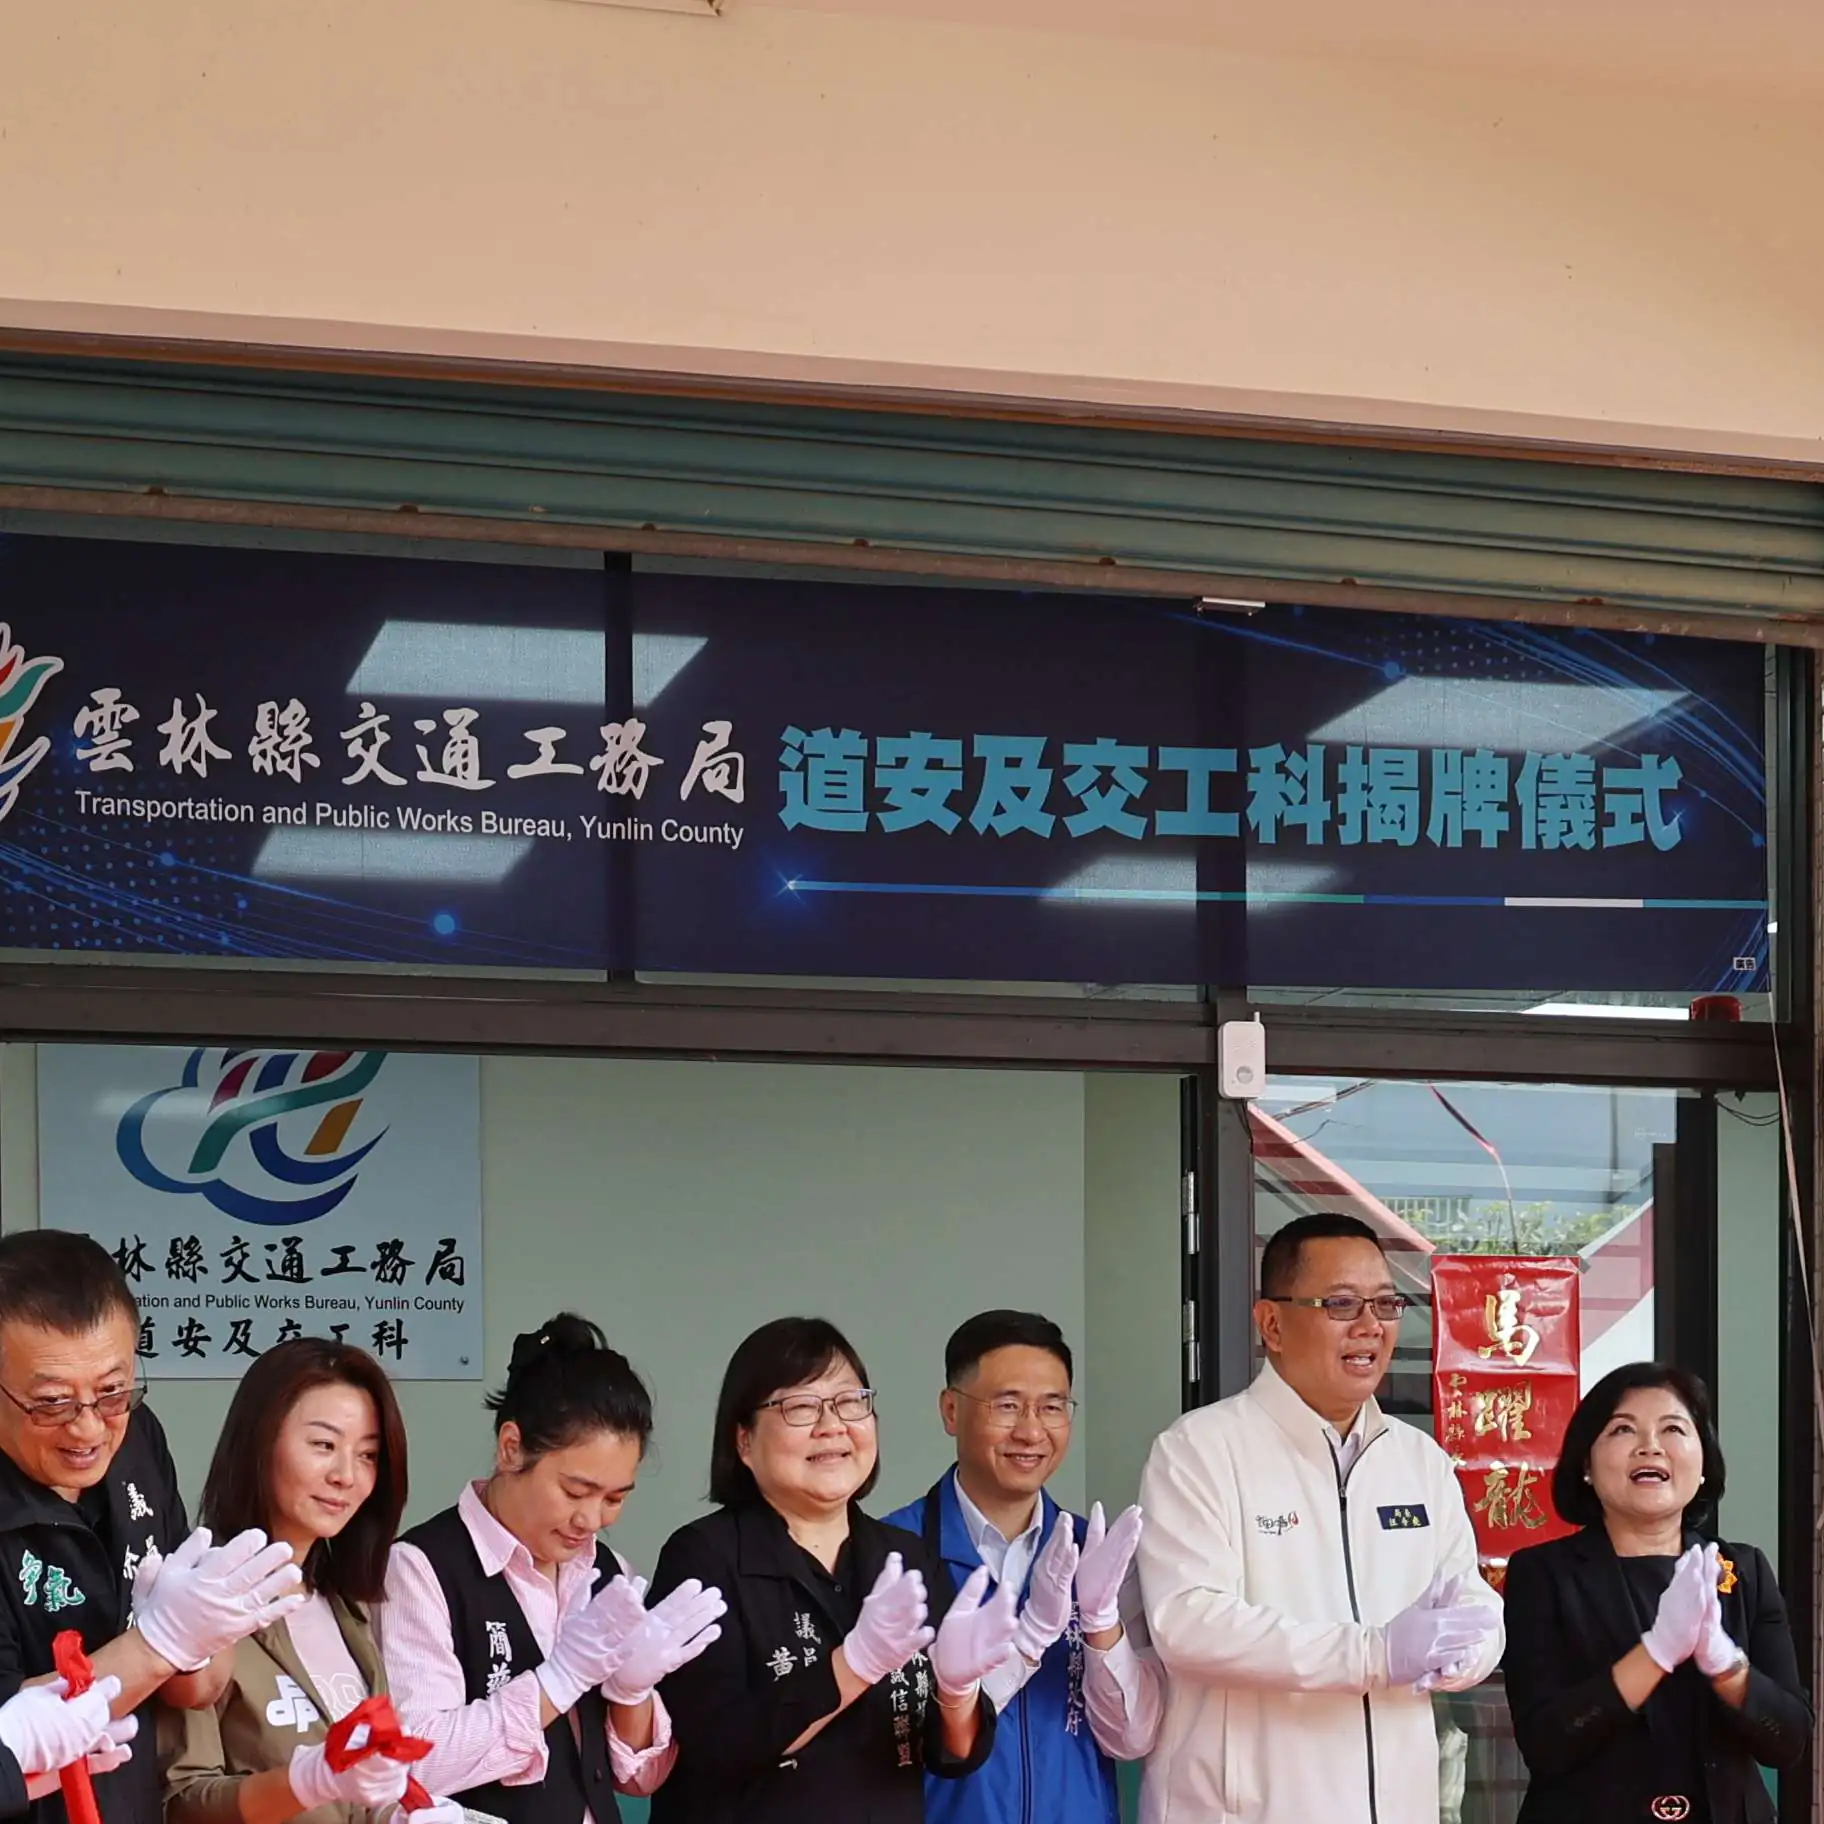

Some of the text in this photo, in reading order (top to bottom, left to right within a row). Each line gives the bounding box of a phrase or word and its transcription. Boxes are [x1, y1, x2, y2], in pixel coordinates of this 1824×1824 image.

[73, 686, 1691, 851] 雲林縣交通工務局 道安及交工科揭牌儀式
[75, 790, 744, 850] Transportation and Public Works Bureau, Yunlin County
[110, 1234, 467, 1288] 林縣交通工務局
[174, 1294, 199, 1309] and
[204, 1294, 251, 1310] Public
[254, 1294, 301, 1310] Works
[304, 1295, 360, 1312] Bureau,
[364, 1295, 410, 1311] Yunlin
[413, 1295, 465, 1314] County
